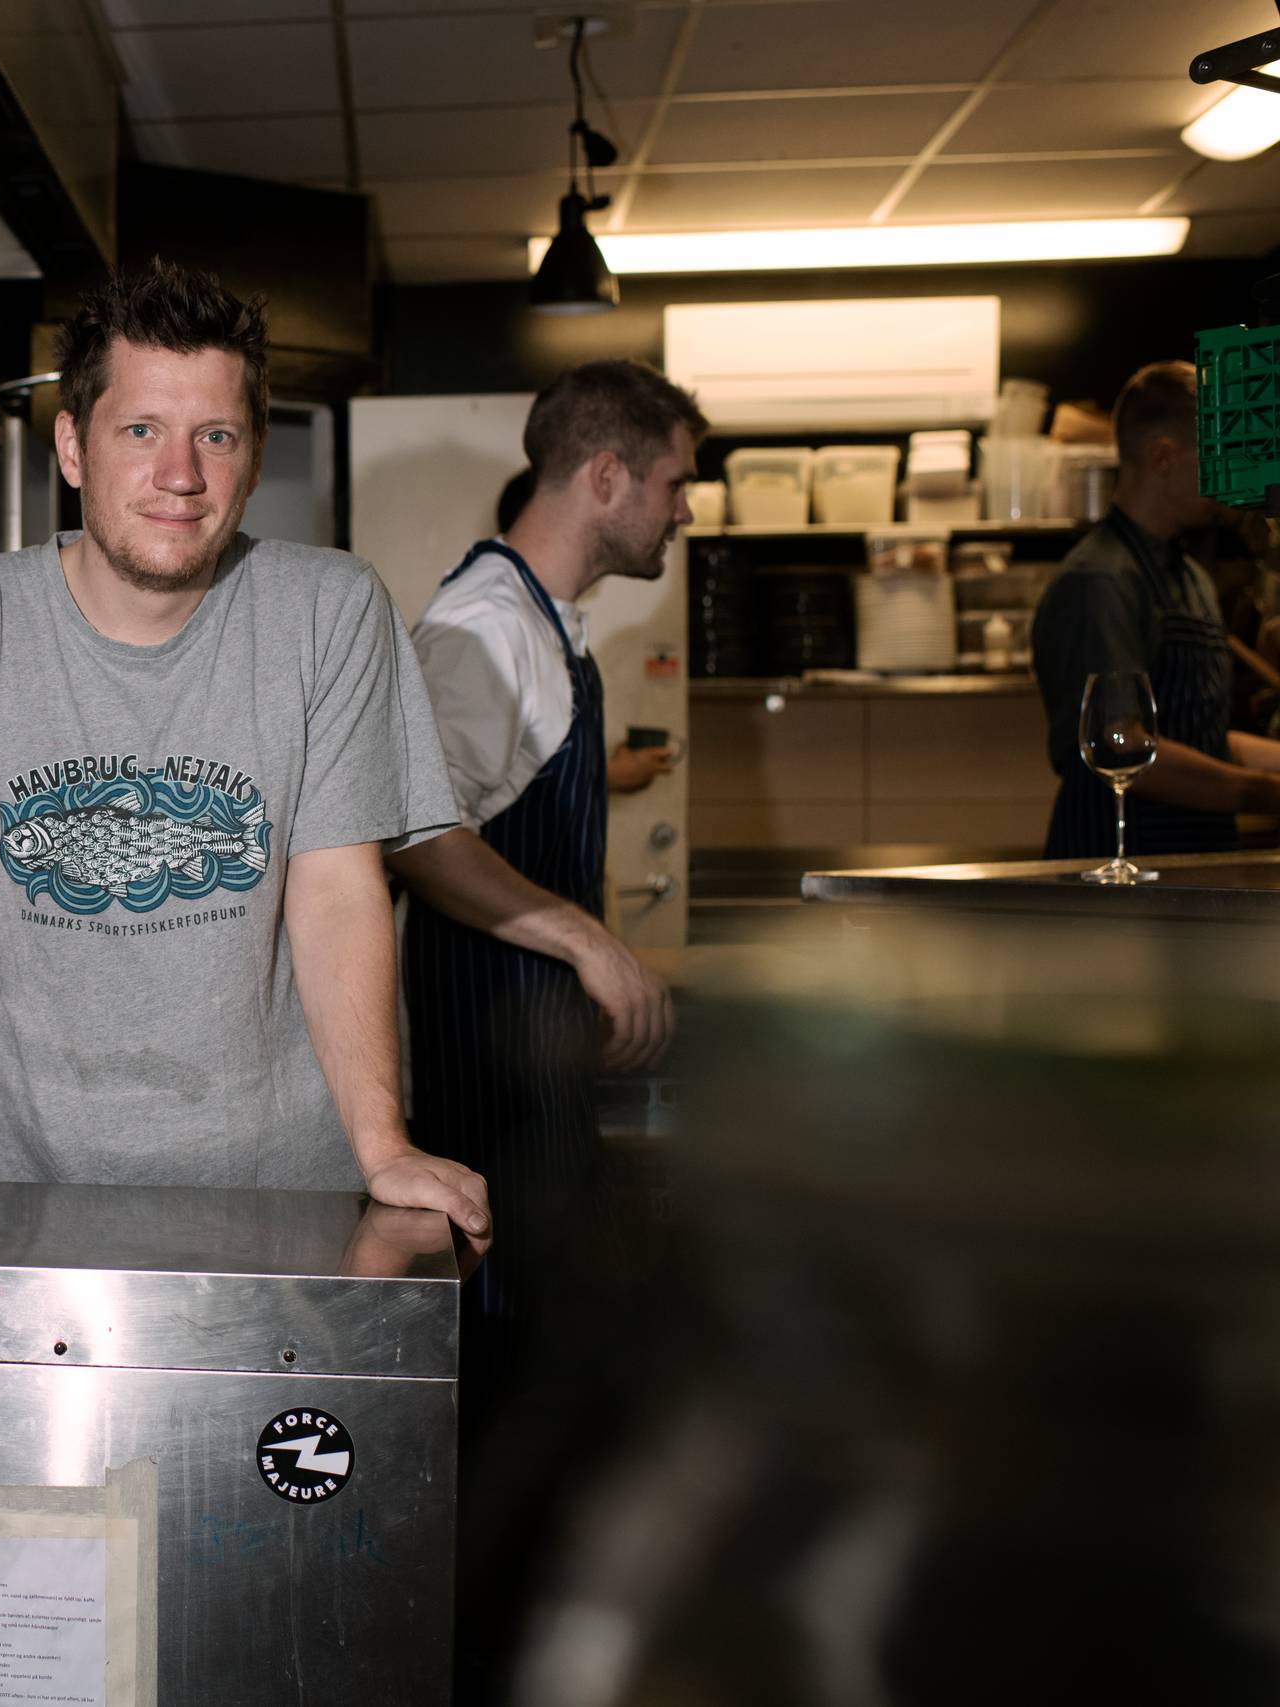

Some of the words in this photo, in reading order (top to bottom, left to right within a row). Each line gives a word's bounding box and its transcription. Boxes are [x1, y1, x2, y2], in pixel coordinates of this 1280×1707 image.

[8, 755, 137, 802] HAVBRUG
[21, 909, 83, 931] DANMARKS
[88, 905, 247, 936] SPORTSFISKERFORBUND
[273, 1412, 338, 1437] FORCE
[261, 1455, 337, 1500] MAJEURE
